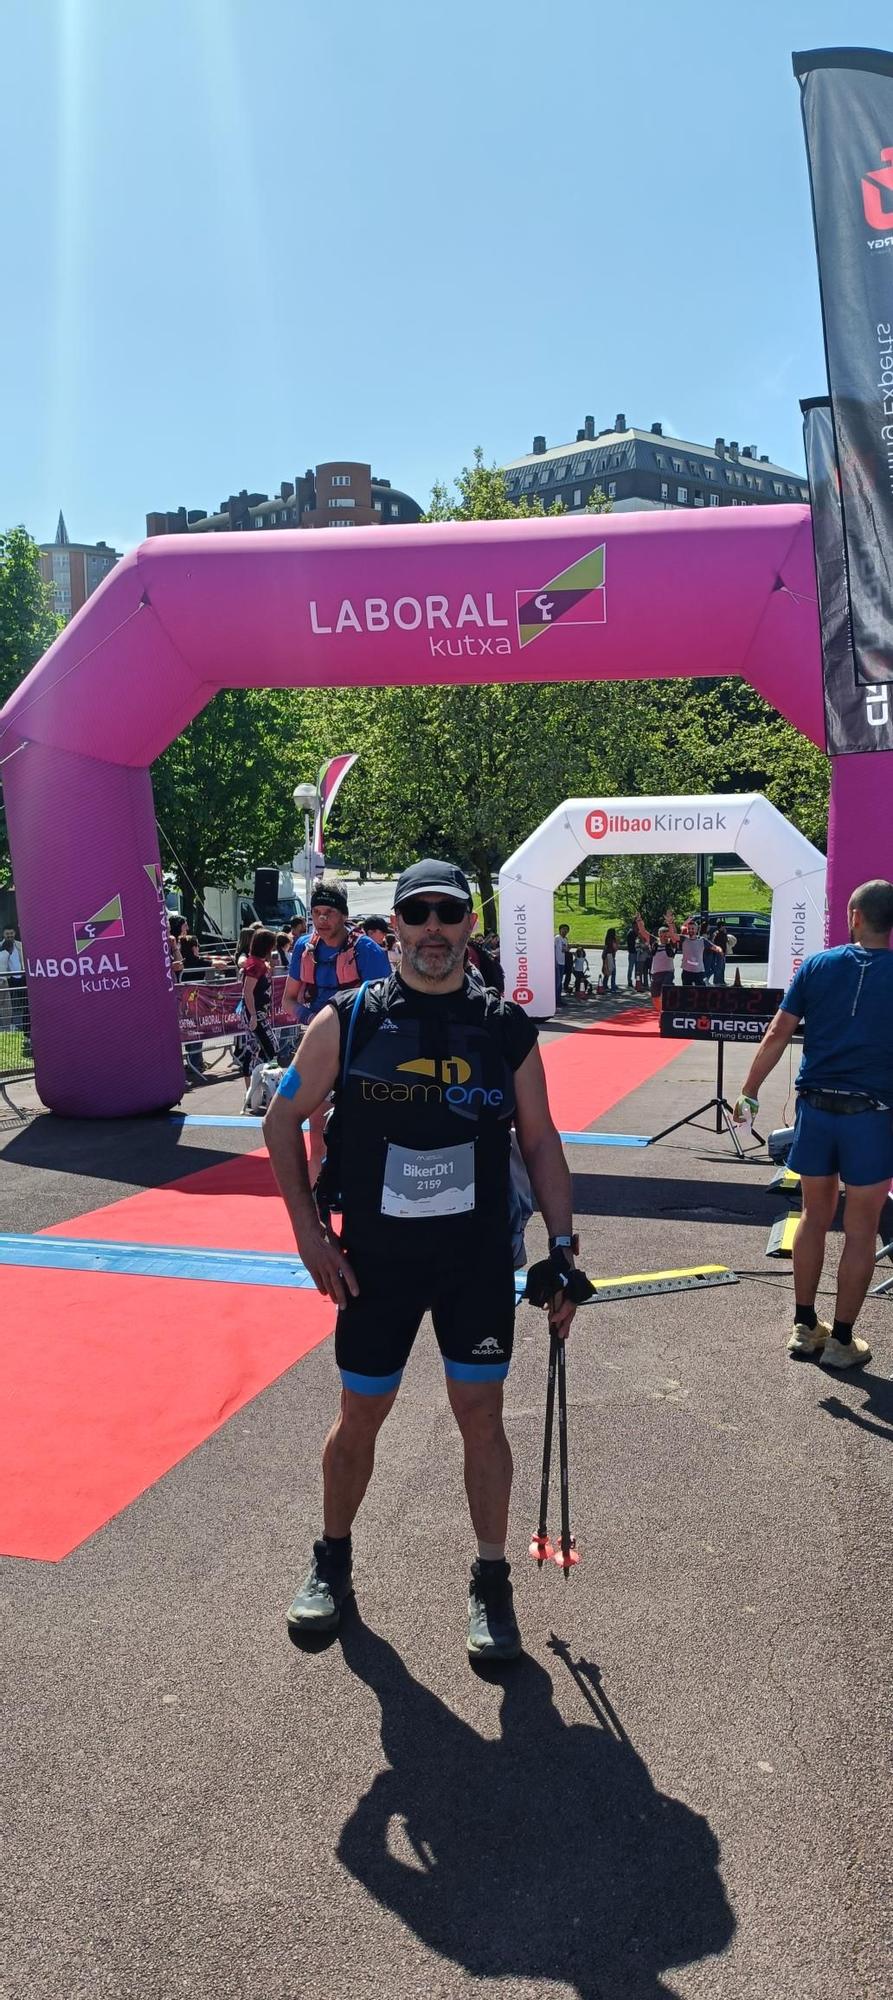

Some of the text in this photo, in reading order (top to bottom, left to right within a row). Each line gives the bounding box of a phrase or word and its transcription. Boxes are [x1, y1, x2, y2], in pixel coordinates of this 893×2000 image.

[309, 593, 508, 634] LABORAL
[429, 634, 512, 657] kutxa
[27, 953, 129, 977] LABORAL
[81, 976, 131, 993] kutxa
[711, 1032, 736, 1041] Timing
[403, 1161, 454, 1177] BikerDt1
[416, 1179, 441, 1190] 2159
